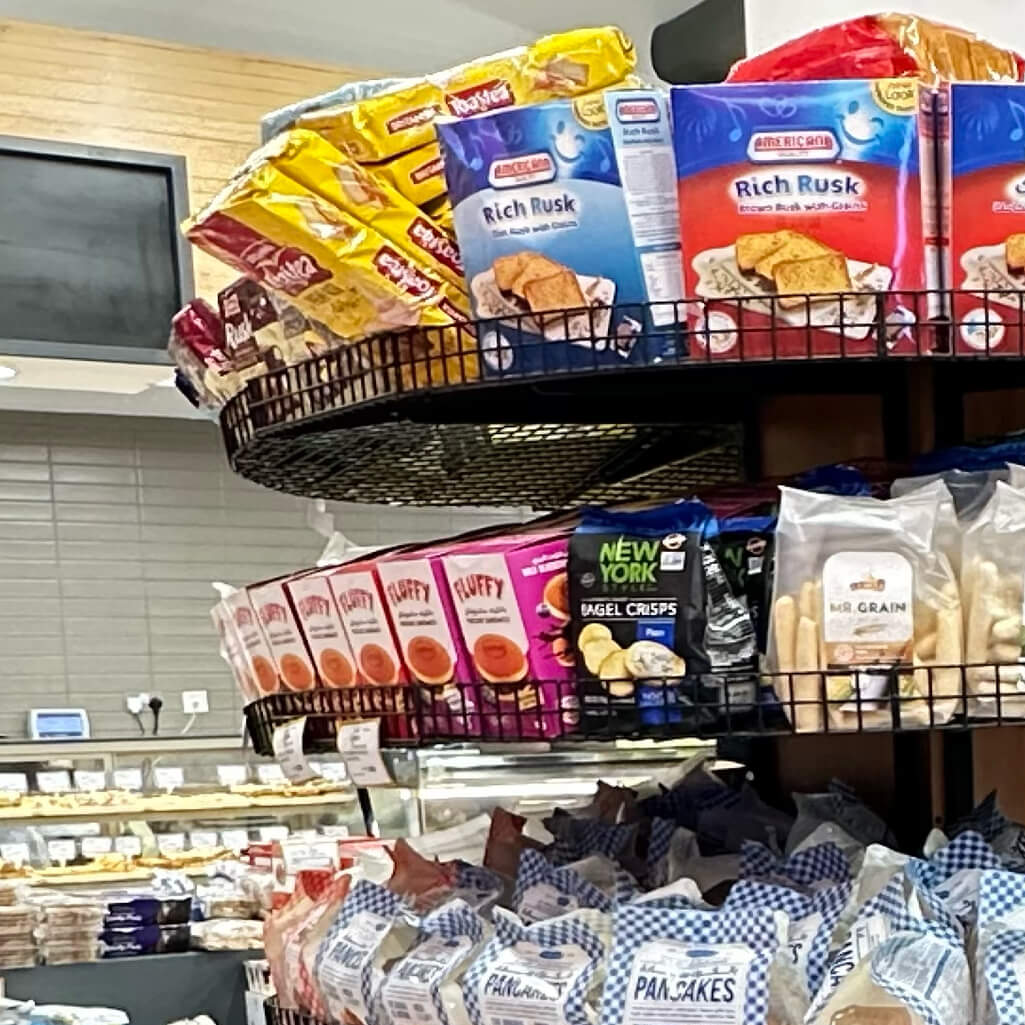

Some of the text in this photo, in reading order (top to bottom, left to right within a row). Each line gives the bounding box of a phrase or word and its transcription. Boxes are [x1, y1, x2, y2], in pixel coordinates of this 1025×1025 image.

[753, 134, 833, 150] AMERICANA
[735, 175, 860, 198] Rich Rusk
[482, 193, 577, 225] Rich Rusk
[599, 534, 660, 563] NEW
[600, 562, 659, 583] YORK
[387, 578, 430, 607] FLUFFY
[453, 573, 505, 603] FLUFFY
[581, 602, 679, 617] BAGEL CRISPS
[857, 601, 907, 614] GRAIN
